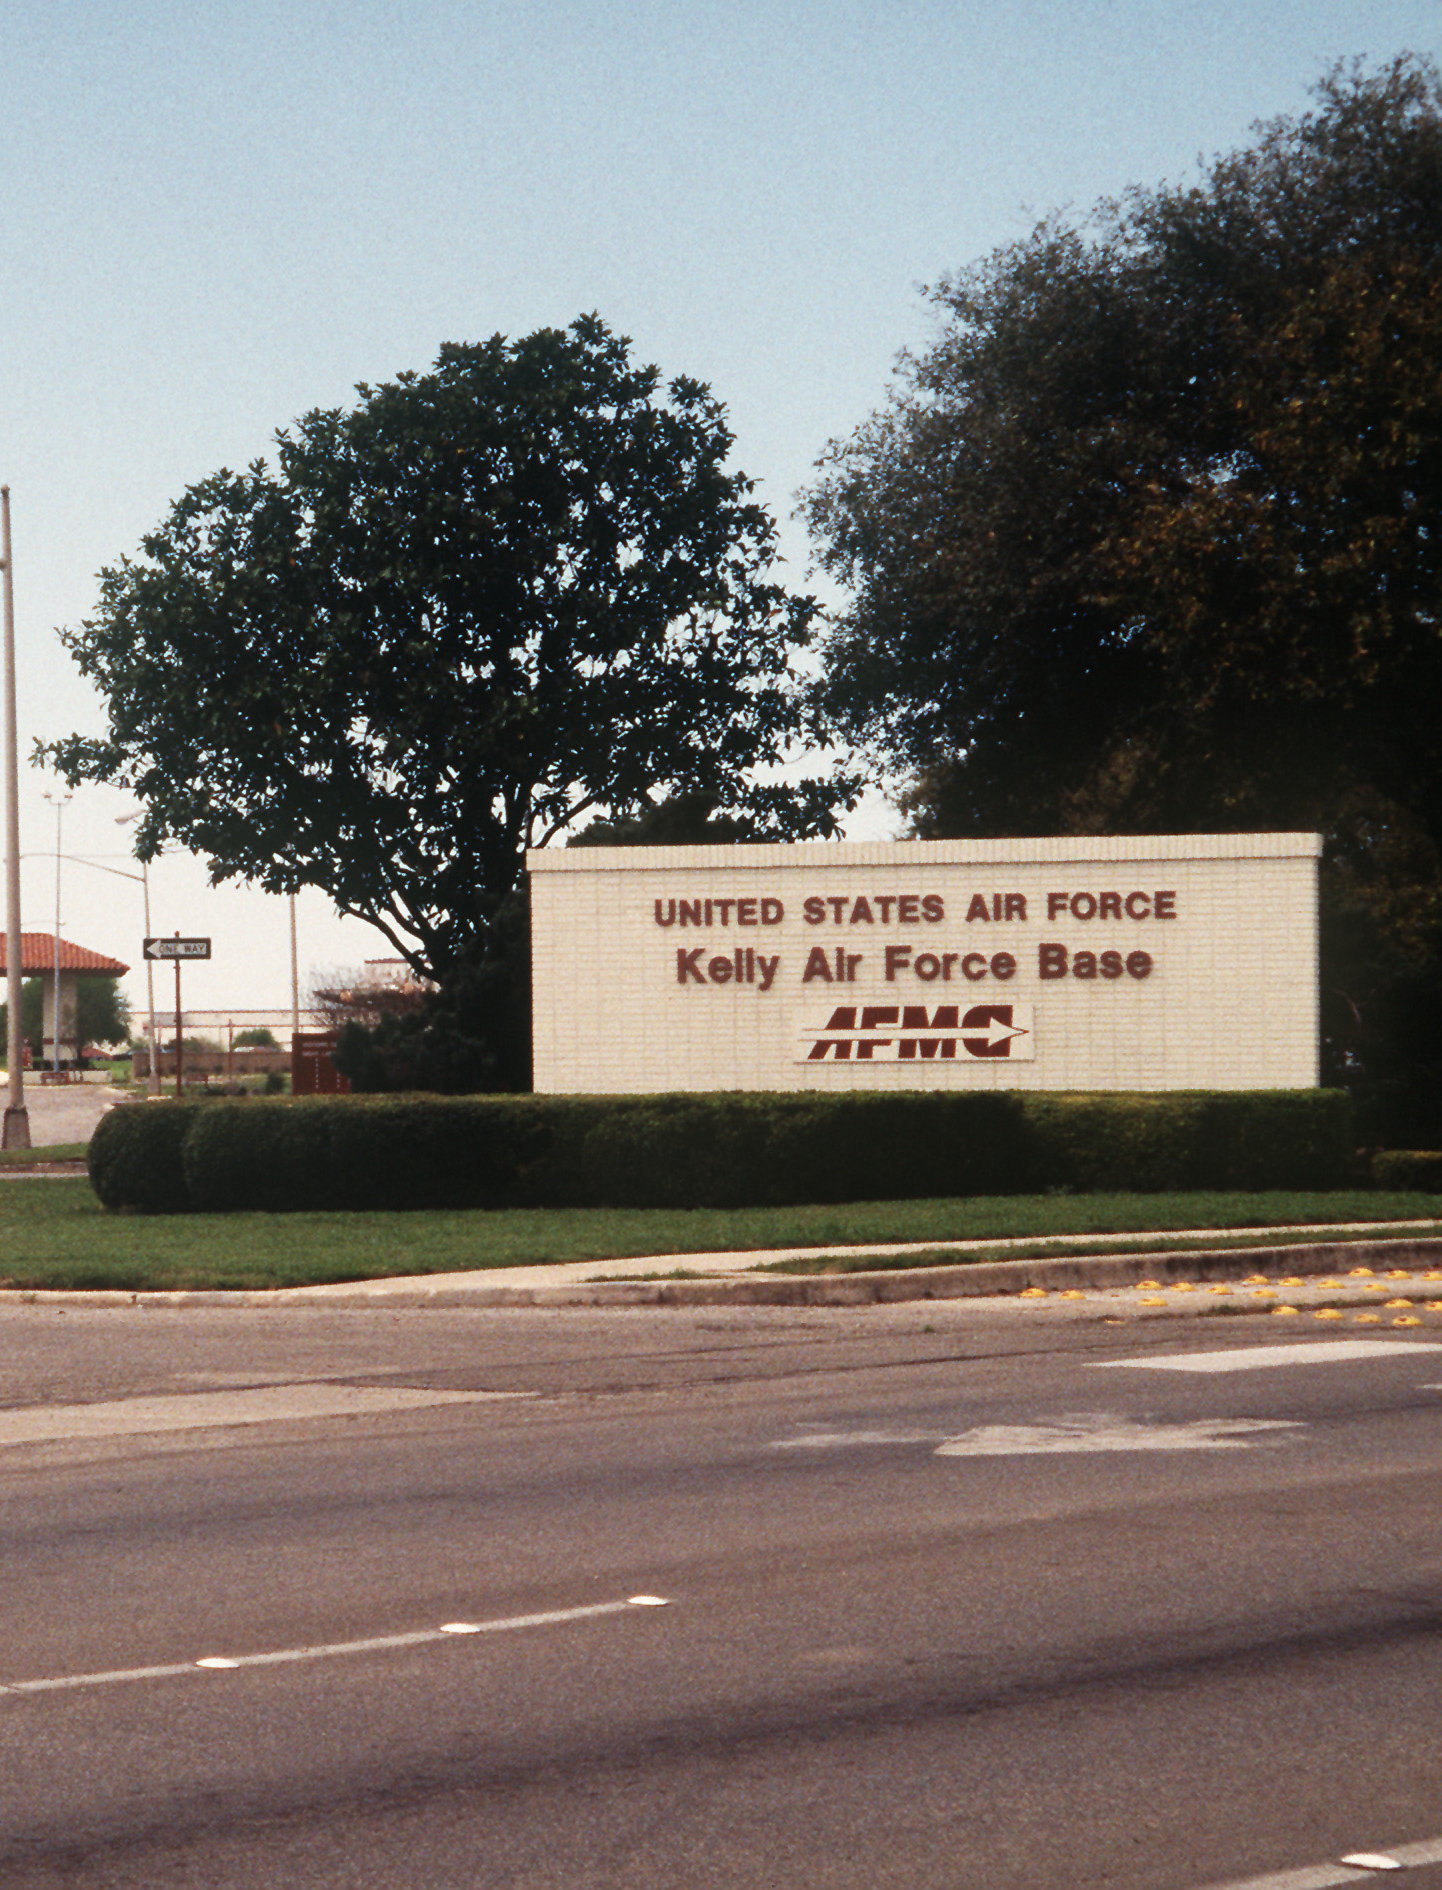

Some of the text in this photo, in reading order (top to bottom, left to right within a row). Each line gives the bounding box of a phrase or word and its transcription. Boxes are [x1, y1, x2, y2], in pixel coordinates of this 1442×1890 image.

[653, 890, 1178, 928] UNITED STATES AIR FORCE
[158, 943, 205, 954] ONE WAY
[676, 942, 1155, 993] Kelly Air Force Base
[807, 1004, 1018, 1060] AFMC
